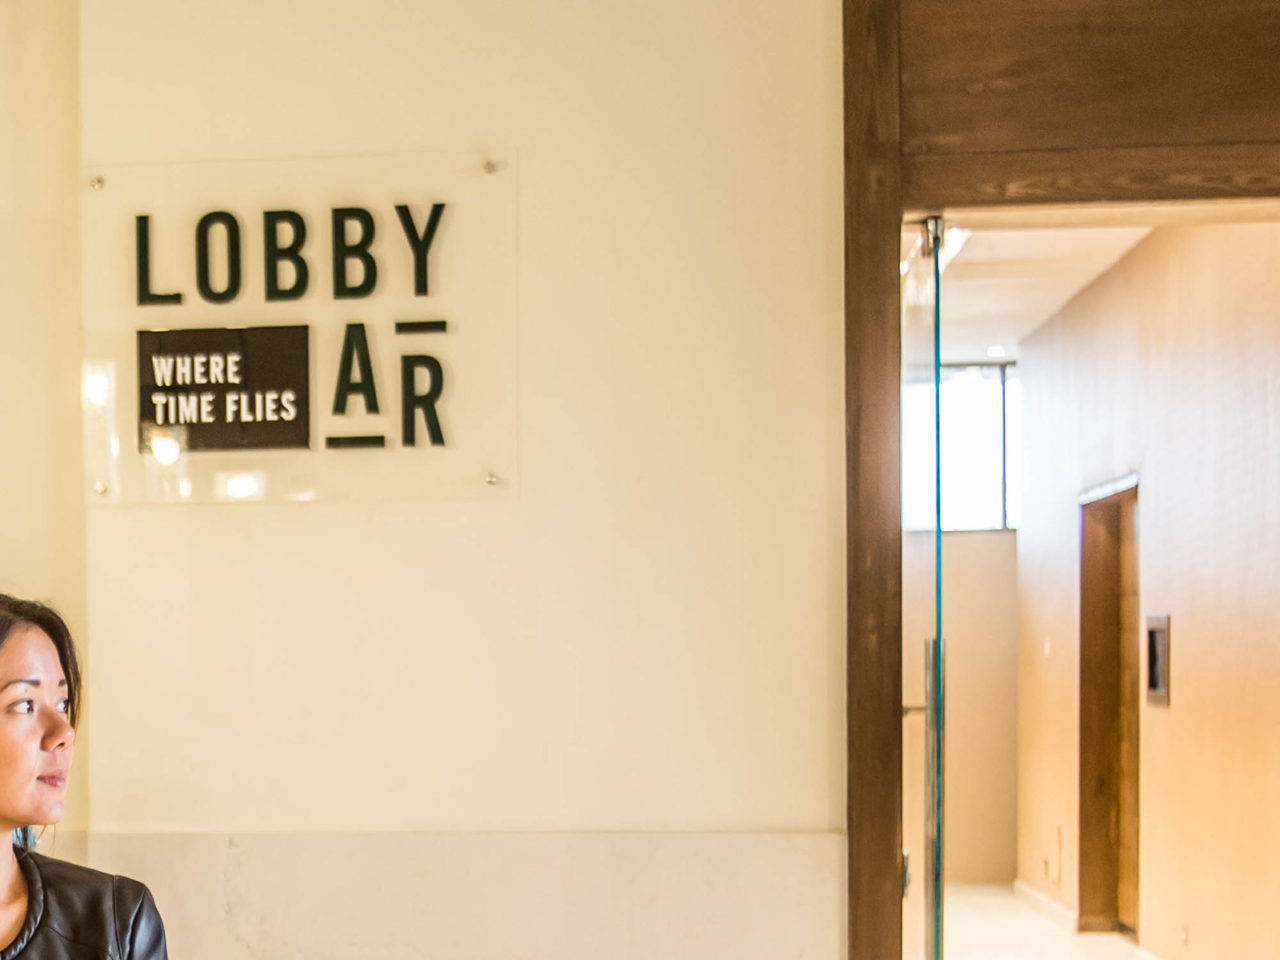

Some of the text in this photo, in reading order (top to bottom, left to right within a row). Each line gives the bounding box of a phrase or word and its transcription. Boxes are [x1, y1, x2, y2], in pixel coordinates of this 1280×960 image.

[135, 203, 445, 305] LOBBY
[151, 353, 242, 387] WHERE
[152, 389, 297, 424] TIME FLIES
